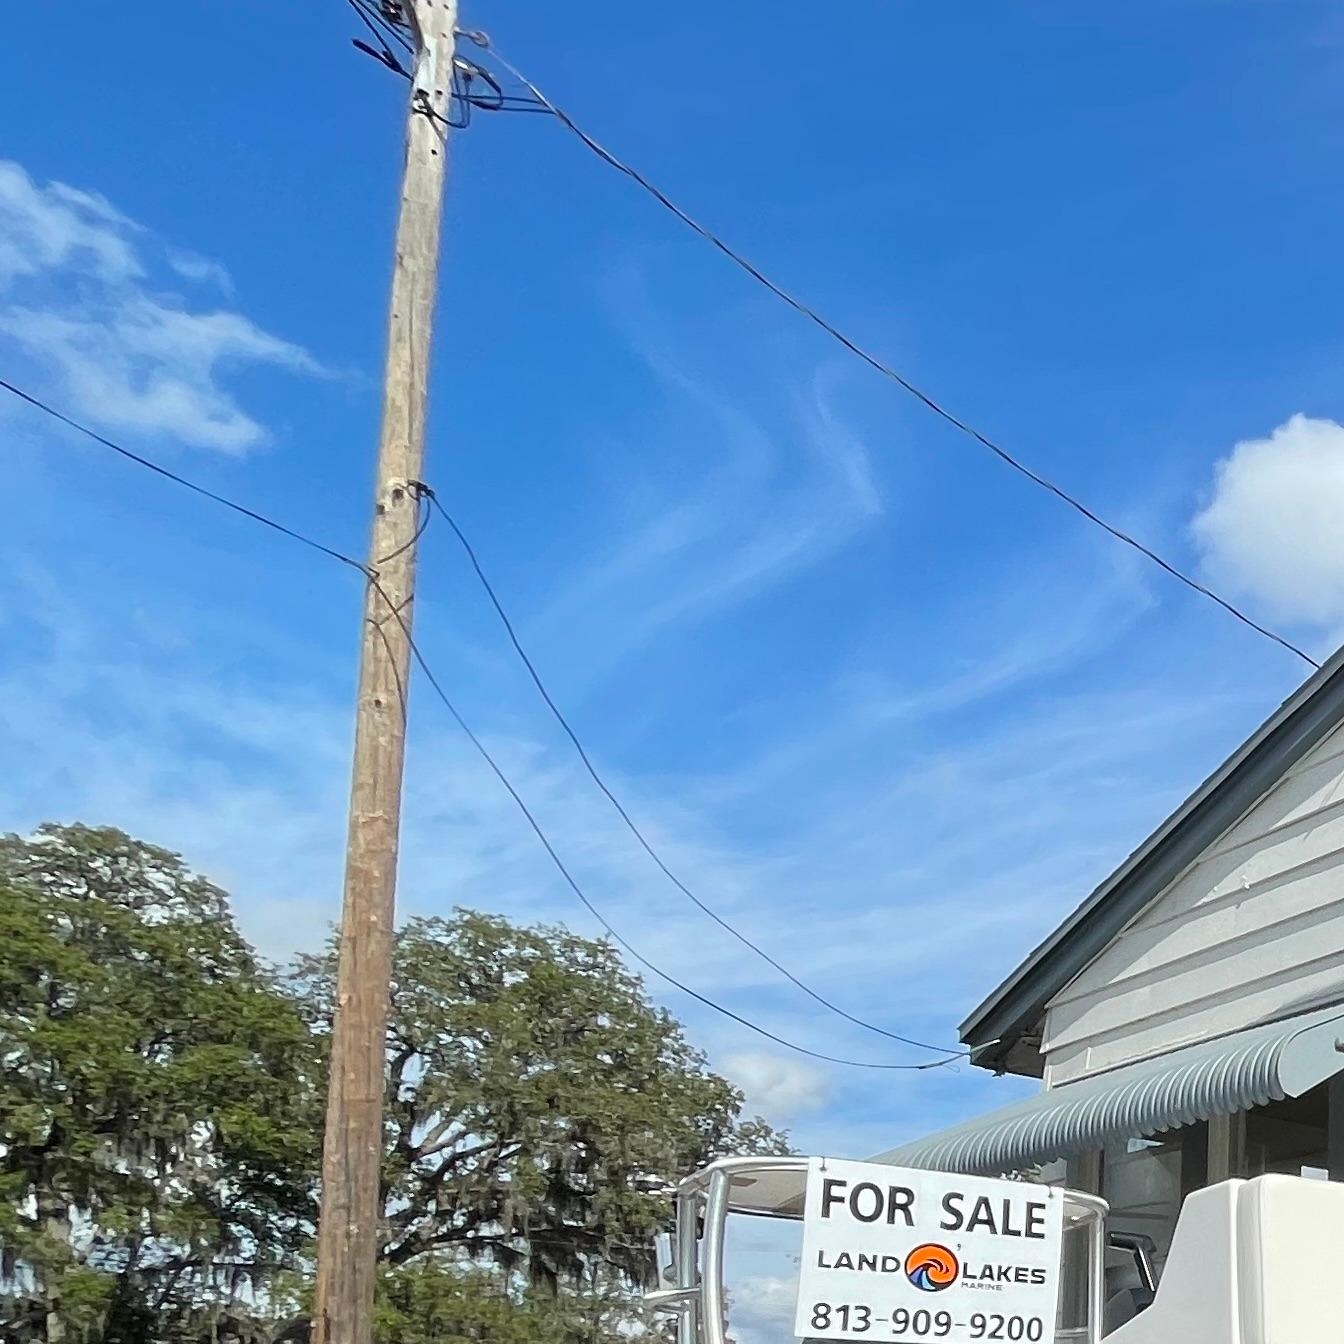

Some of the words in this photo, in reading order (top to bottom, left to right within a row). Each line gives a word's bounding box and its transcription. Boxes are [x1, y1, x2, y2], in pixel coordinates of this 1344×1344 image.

[820, 1177, 915, 1227] FOR
[939, 1191, 1046, 1240] SALE
[817, 1249, 902, 1273] LAND
[961, 1261, 1047, 1285] LAKES
[961, 1281, 1004, 1292] MARINE
[810, 1302, 1044, 1342] 813-909-9200
